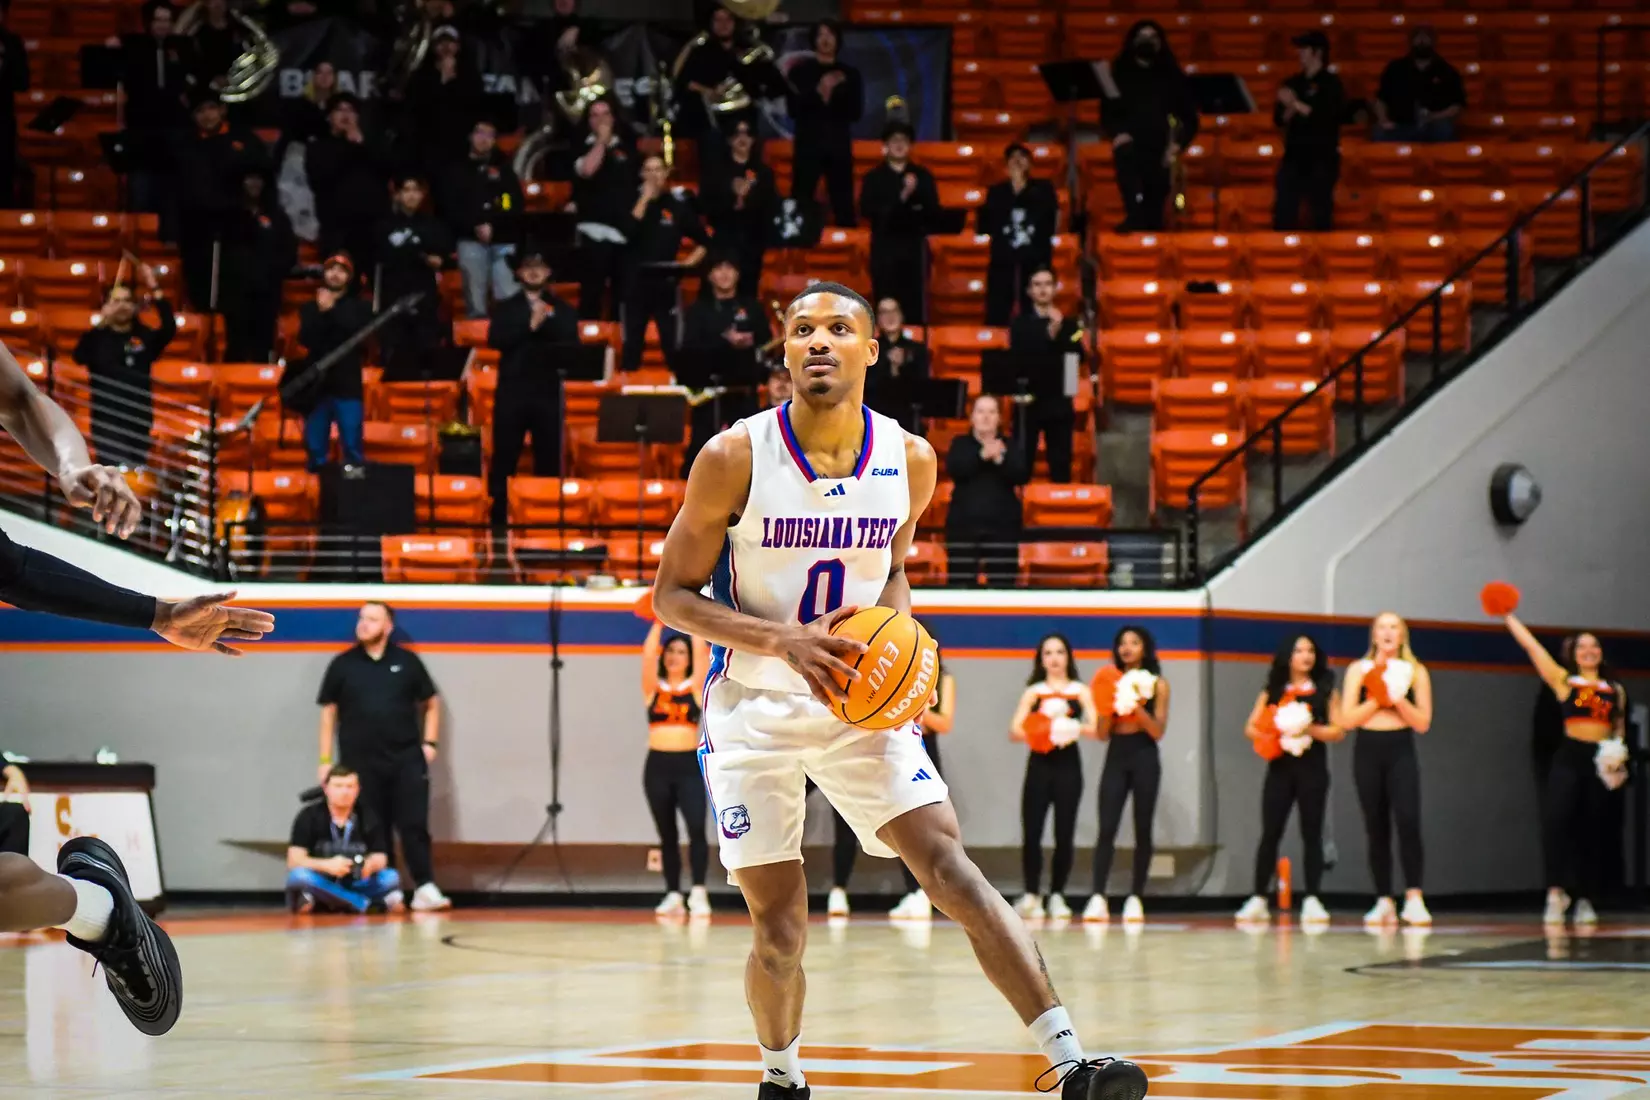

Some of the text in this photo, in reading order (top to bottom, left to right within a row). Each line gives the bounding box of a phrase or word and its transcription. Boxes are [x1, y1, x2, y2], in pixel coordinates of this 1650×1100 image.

[871, 468, 899, 477] C-USA
[761, 517, 853, 549] LOUISIANA
[797, 558, 845, 626] 0
[867, 640, 900, 692] EVO
[883, 647, 935, 720] Wilson
